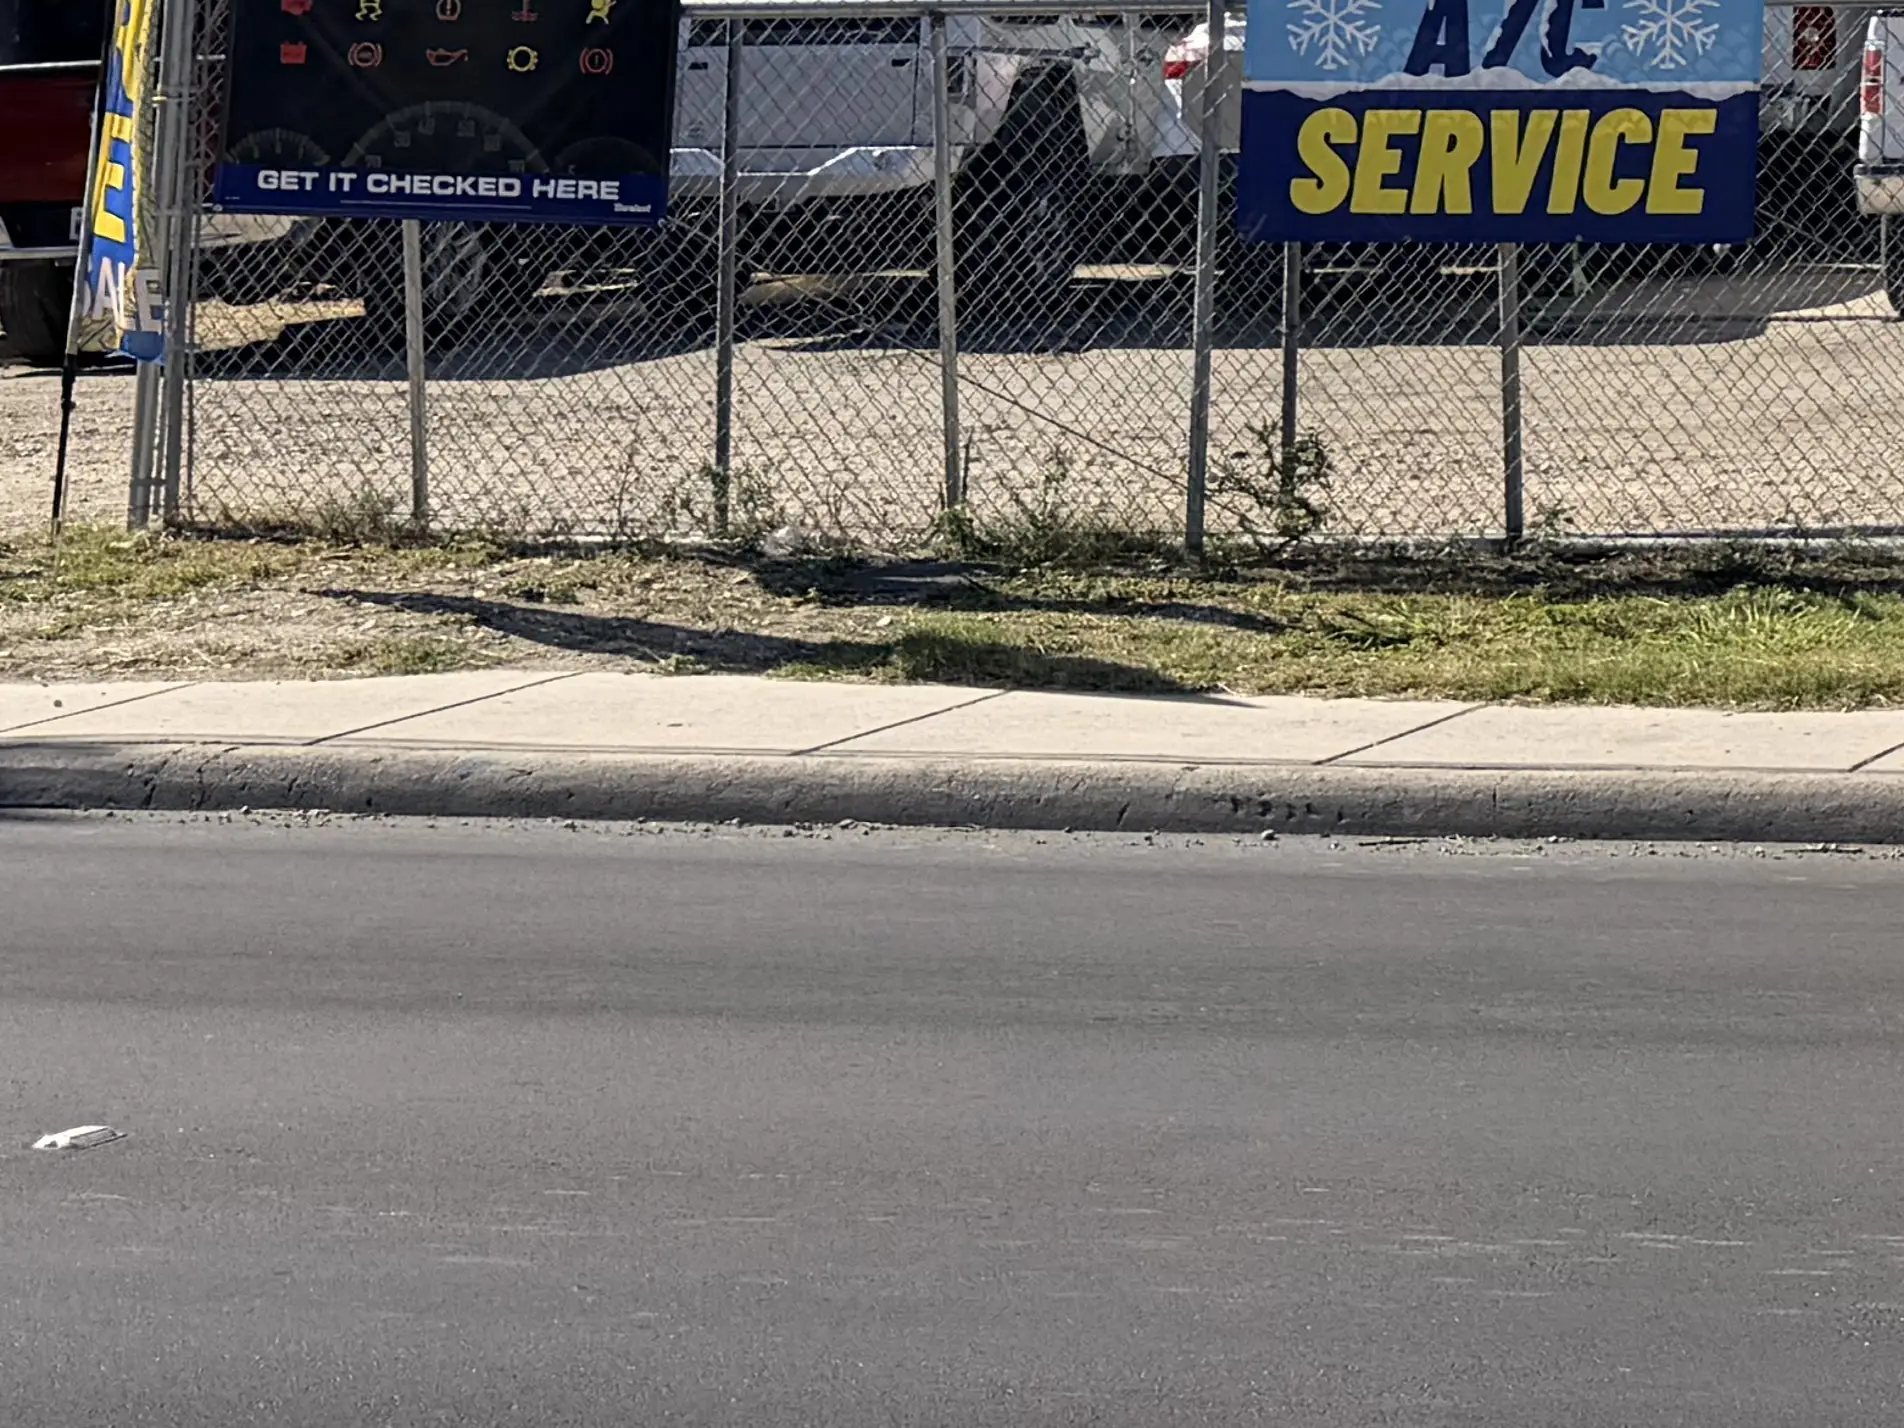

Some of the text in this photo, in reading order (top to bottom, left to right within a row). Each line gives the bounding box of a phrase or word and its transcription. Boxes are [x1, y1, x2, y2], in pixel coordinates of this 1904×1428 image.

[257, 169, 620, 202] GET IT CHECKED HERE
[1289, 107, 1719, 216] SERVICE
